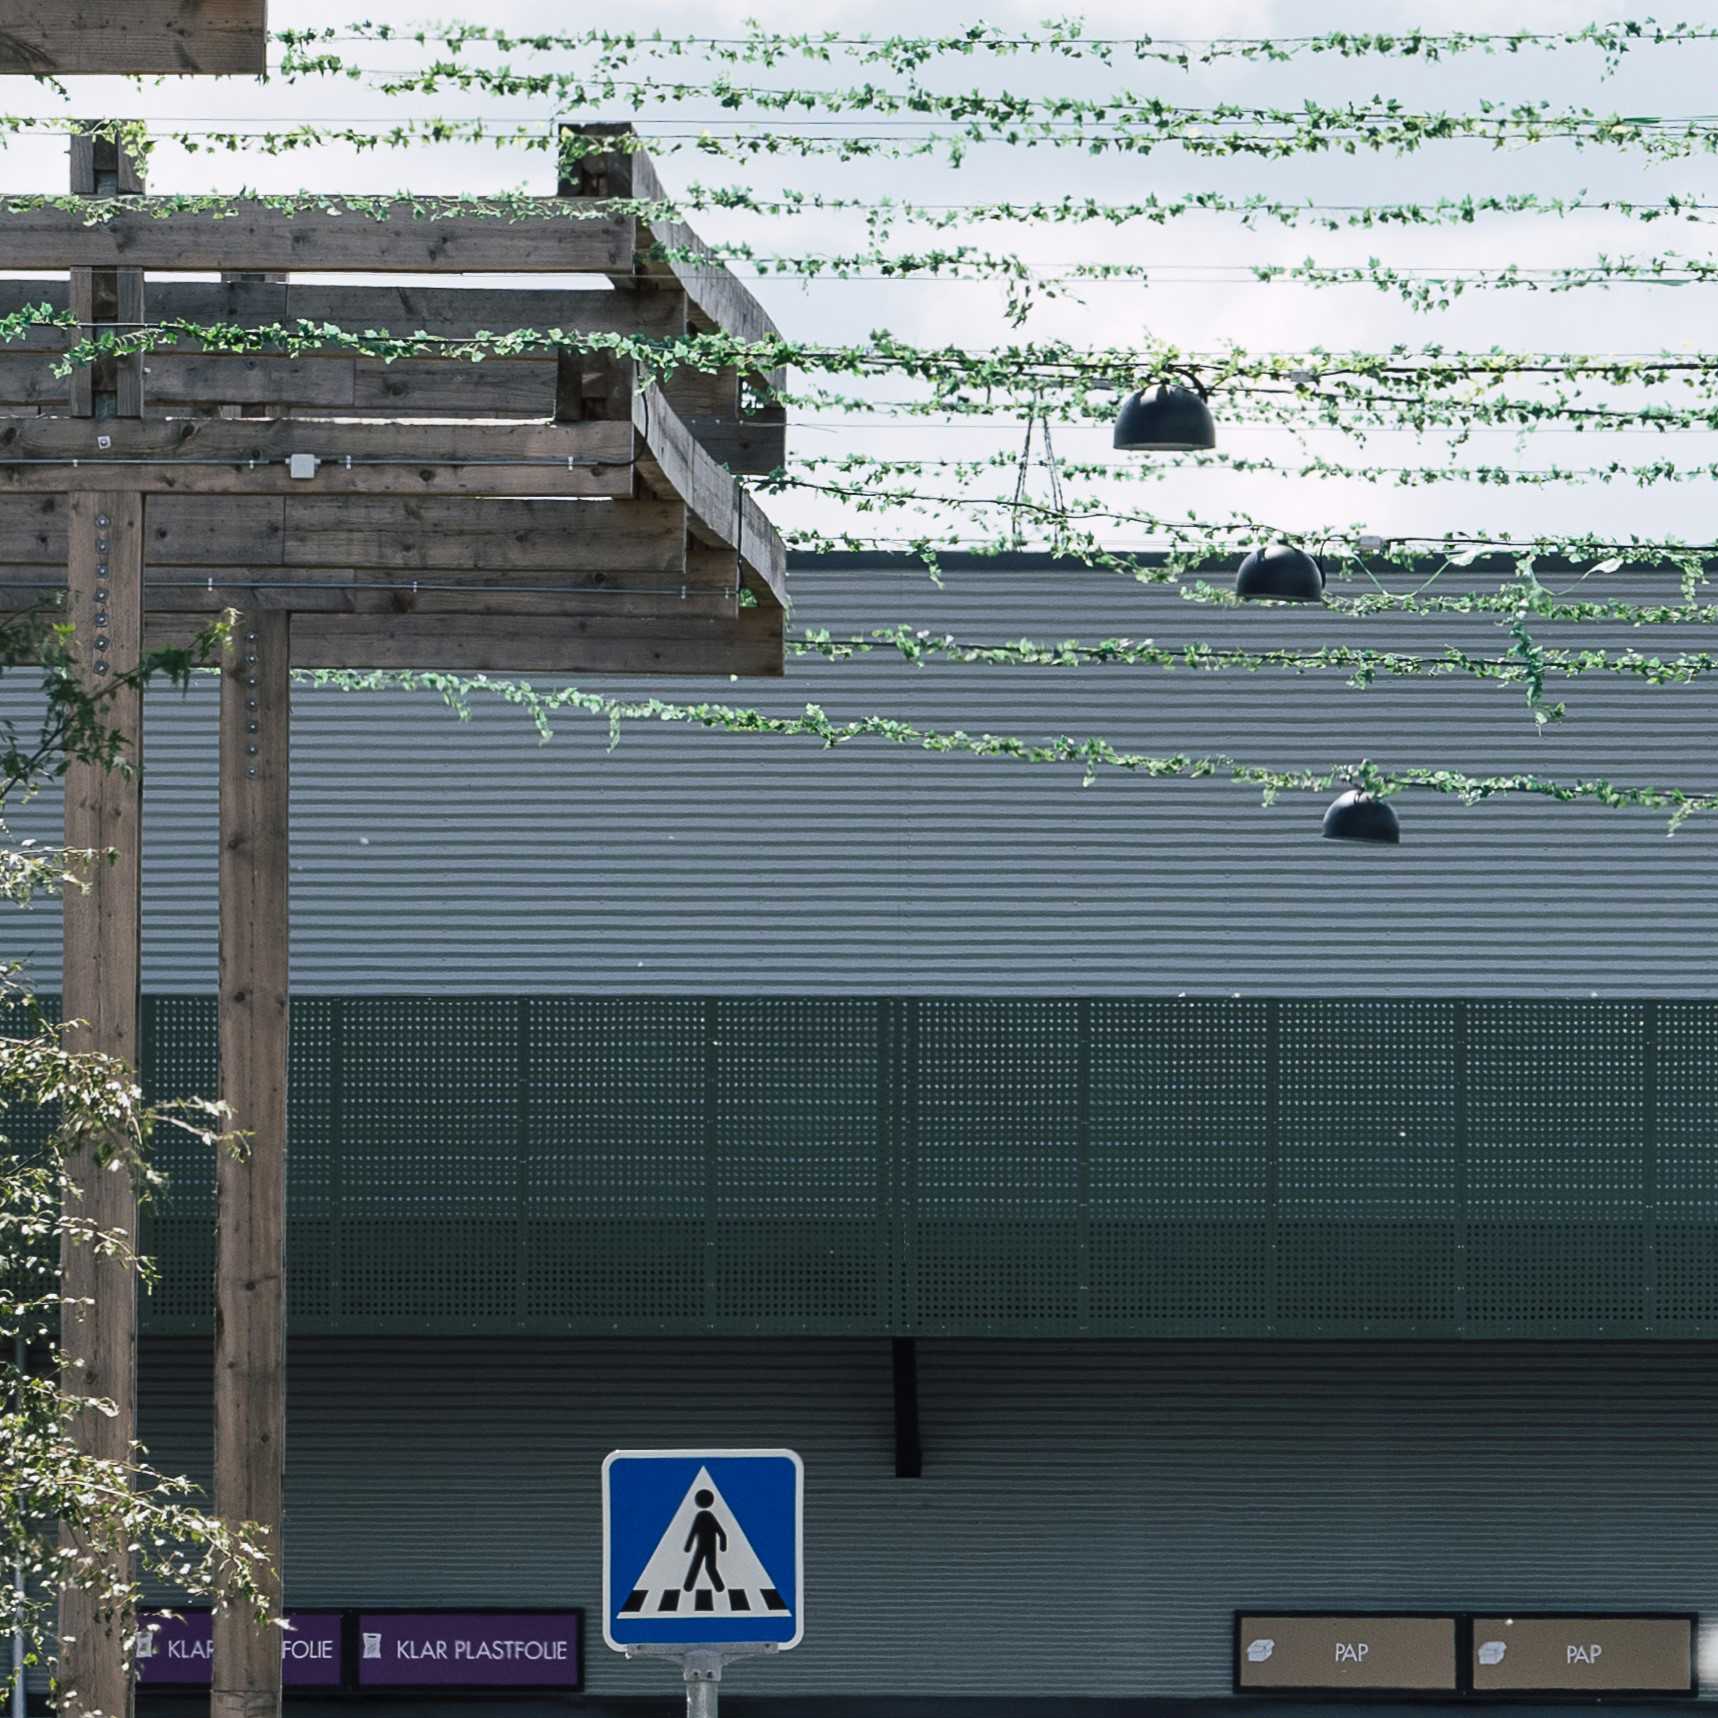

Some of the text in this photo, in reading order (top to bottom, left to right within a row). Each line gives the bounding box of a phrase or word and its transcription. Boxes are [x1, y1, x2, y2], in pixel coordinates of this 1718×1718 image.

[168, 1640, 214, 1659] KLAR
[396, 1640, 567, 1660] KLAR PLASTFOLIE
[1335, 1643, 1369, 1663] PAP
[1567, 1645, 1602, 1664] PAP
